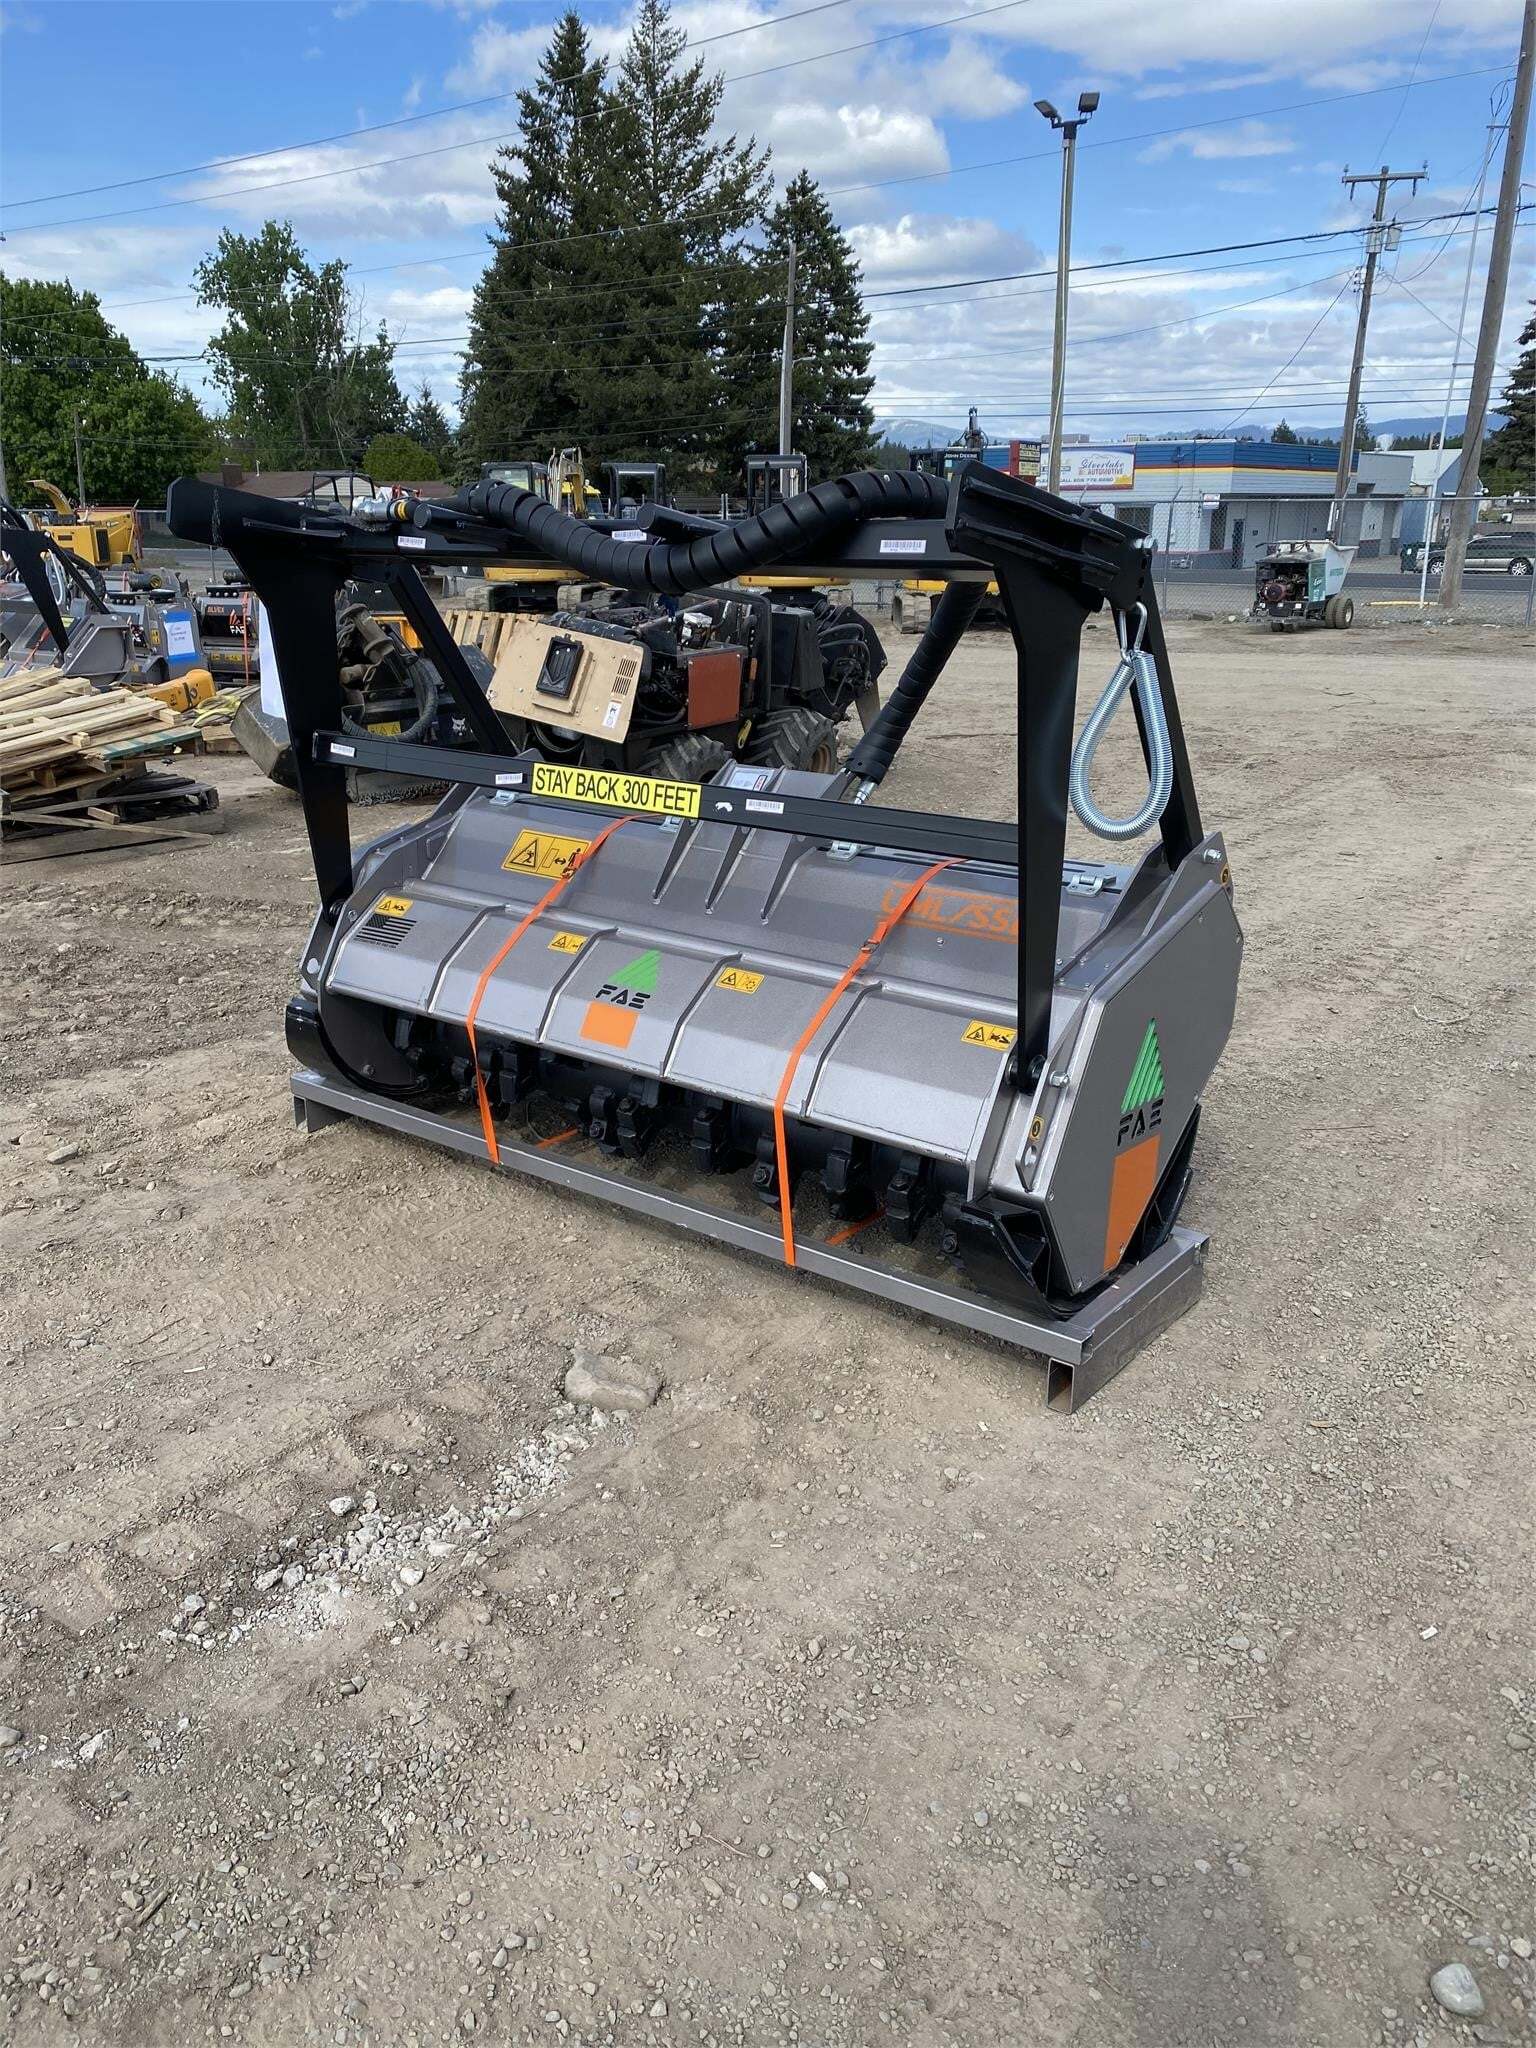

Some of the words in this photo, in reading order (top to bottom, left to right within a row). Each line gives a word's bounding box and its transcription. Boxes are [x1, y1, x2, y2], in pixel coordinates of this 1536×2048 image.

[535, 767, 573, 794] STAY
[575, 773, 619, 802] BACK
[622, 779, 649, 806] 300
[653, 783, 698, 813] FEET
[595, 984, 651, 1009] FAE
[1117, 1098, 1164, 1147] FAE
